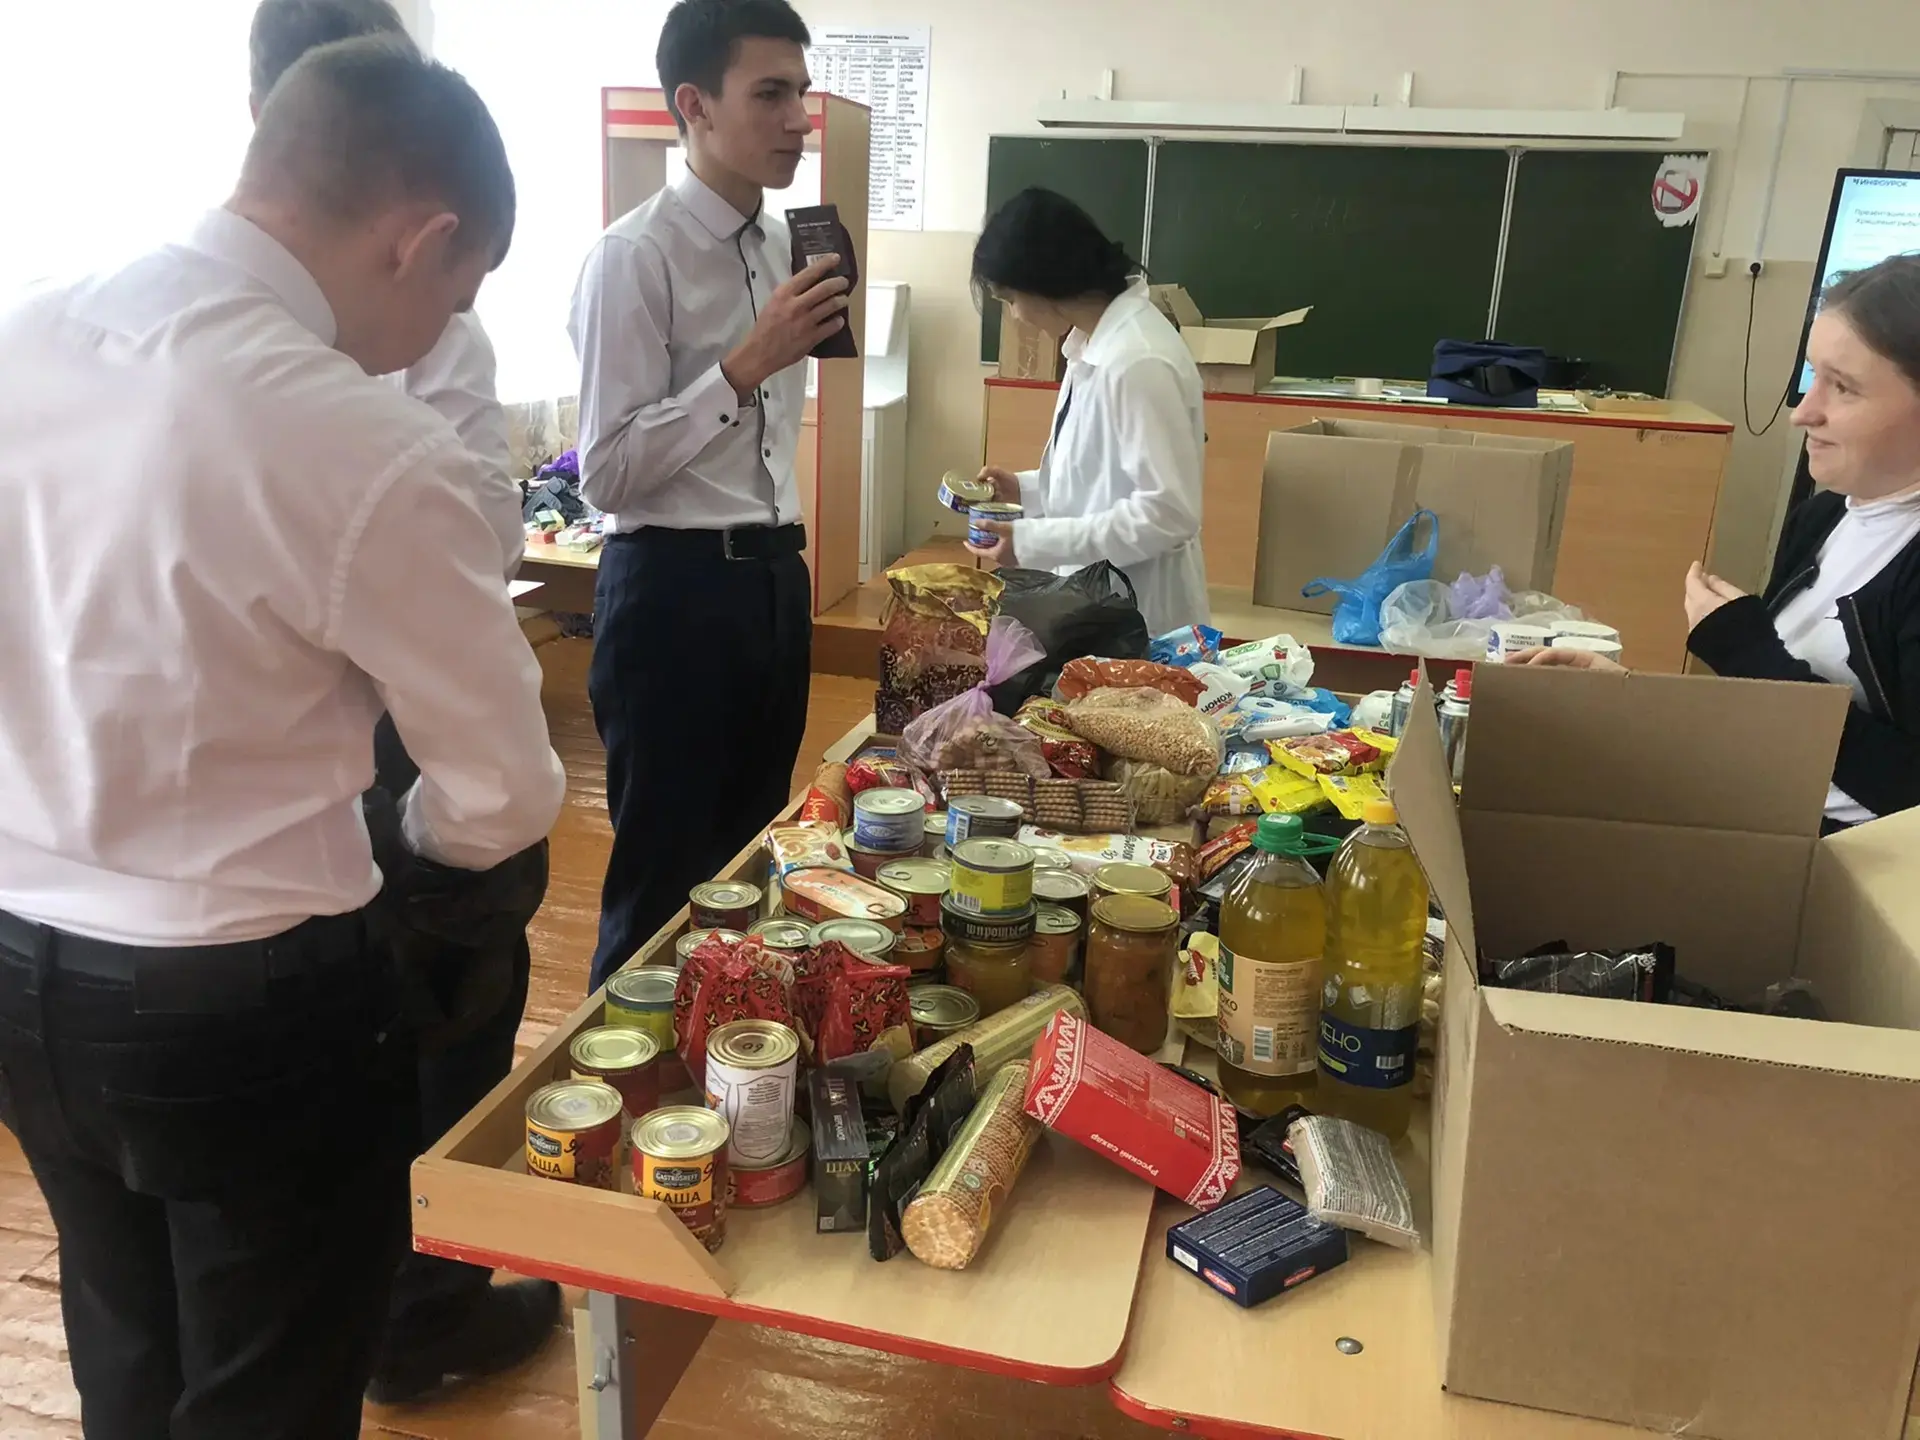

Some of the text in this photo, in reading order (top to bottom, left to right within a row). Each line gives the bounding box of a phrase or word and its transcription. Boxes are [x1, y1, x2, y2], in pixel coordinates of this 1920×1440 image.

[1090, 1133, 1159, 1177] Русский сахар
[826, 1161, 861, 1173] ШАХ
[653, 1190, 701, 1205] КАША
